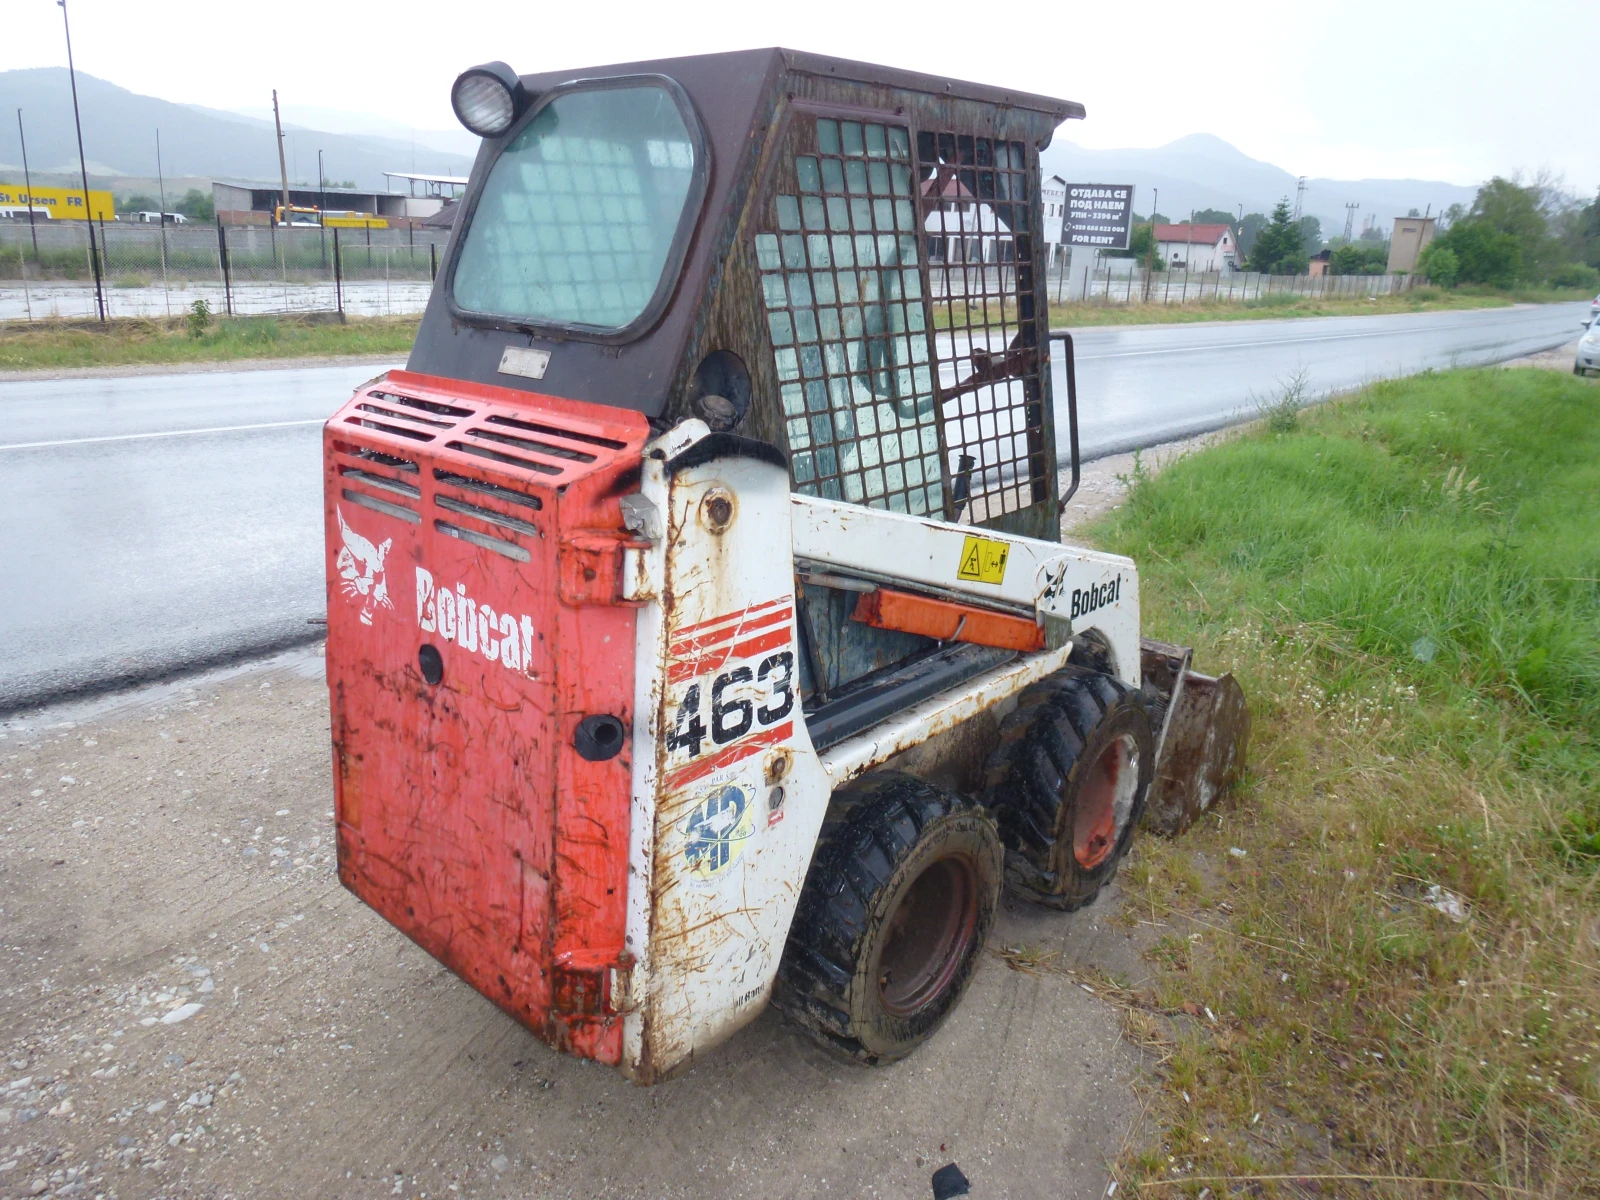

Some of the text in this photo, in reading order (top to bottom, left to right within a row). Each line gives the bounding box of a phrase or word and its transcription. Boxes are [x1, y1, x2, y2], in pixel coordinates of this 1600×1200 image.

[1070, 188, 1127, 199] ОТДАВА СЕ
[18, 194, 57, 205] Ursen
[66, 197, 83, 206] FR
[1070, 200, 1125, 210] ПОД НАЕМ
[1072, 235, 1114, 244] FOR RENT
[1071, 573, 1121, 620] Bobcat
[415, 566, 536, 674] Bobcat
[666, 651, 794, 758] 463
